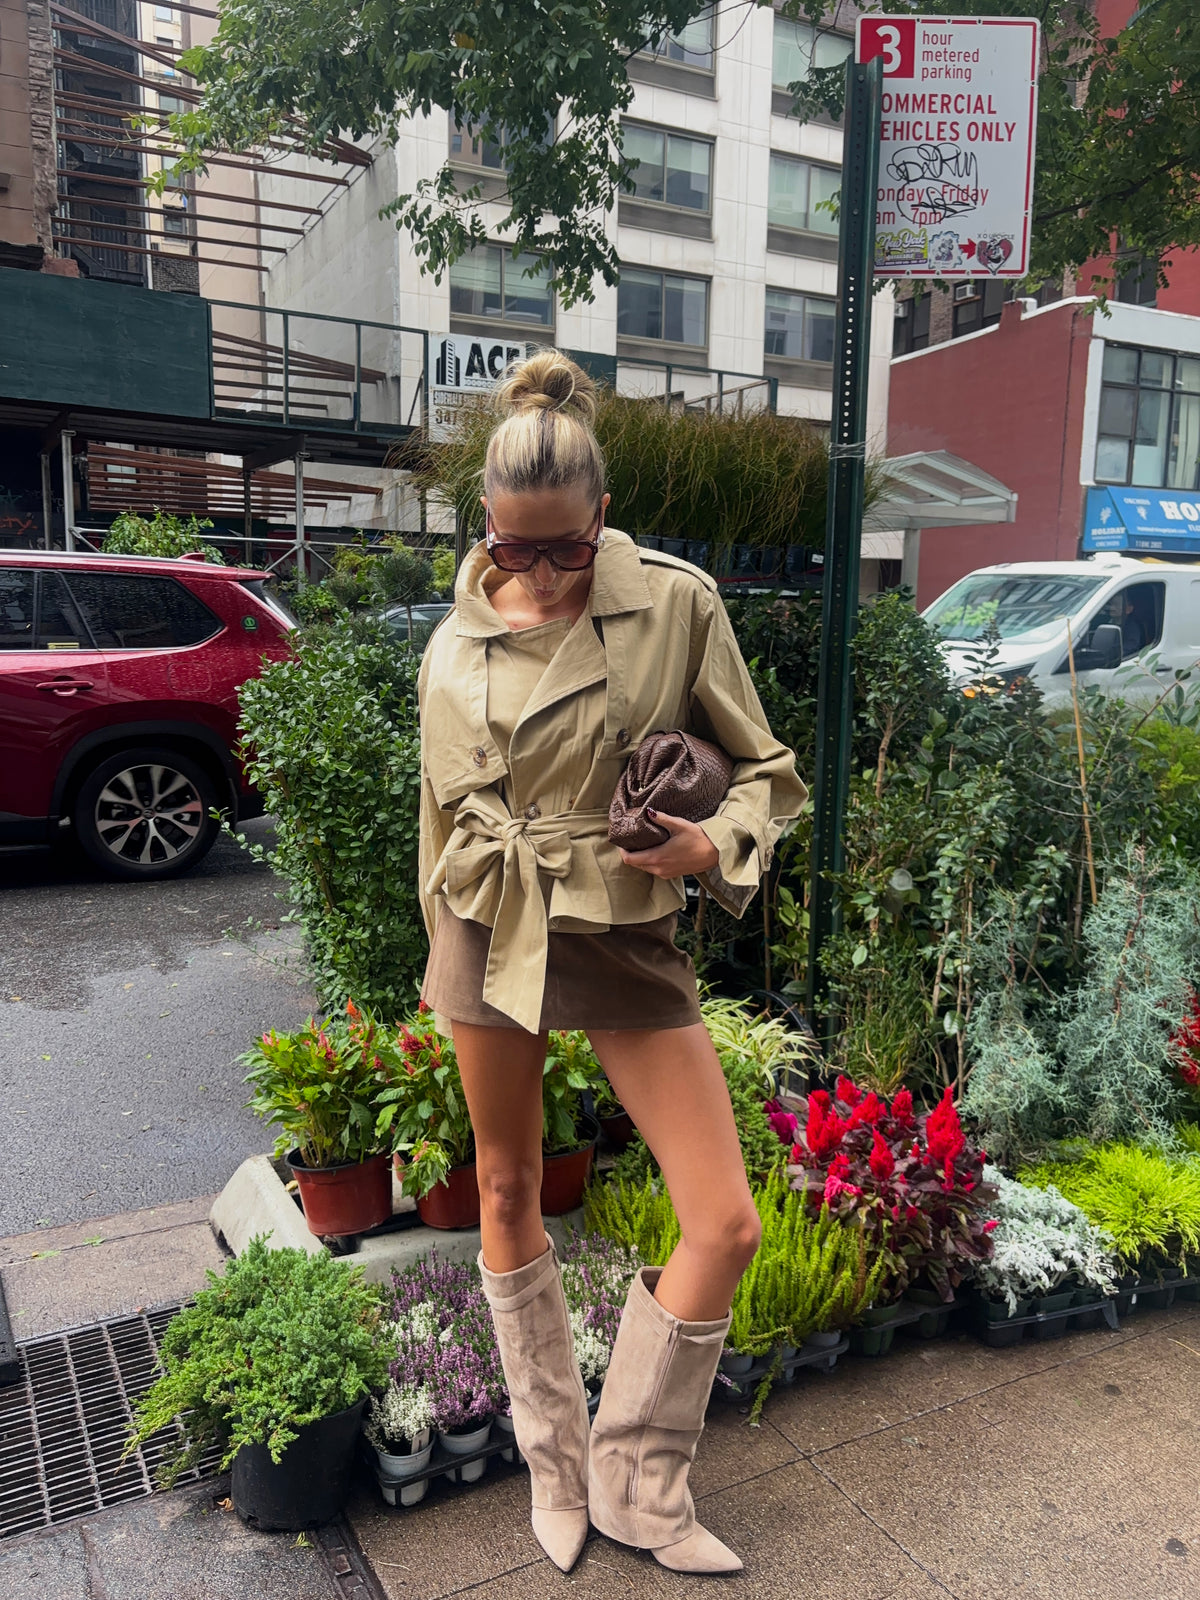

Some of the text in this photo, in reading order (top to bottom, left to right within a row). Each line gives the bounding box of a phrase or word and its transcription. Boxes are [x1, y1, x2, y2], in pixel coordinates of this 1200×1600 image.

[923, 30, 954, 46] hour
[876, 25, 902, 73] 3
[922, 49, 980, 63] metered
[921, 64, 972, 83] parking
[882, 93, 997, 115] OMMERCIAL
[880, 121, 1016, 142] EHICLES ONLY
[877, 184, 925, 205] onday
[941, 184, 989, 206] Friday
[876, 211, 896, 225] am
[911, 208, 942, 228] 7pm
[1158, 500, 1200, 522] HO
[1091, 526, 1126, 536] HOLIDAY
